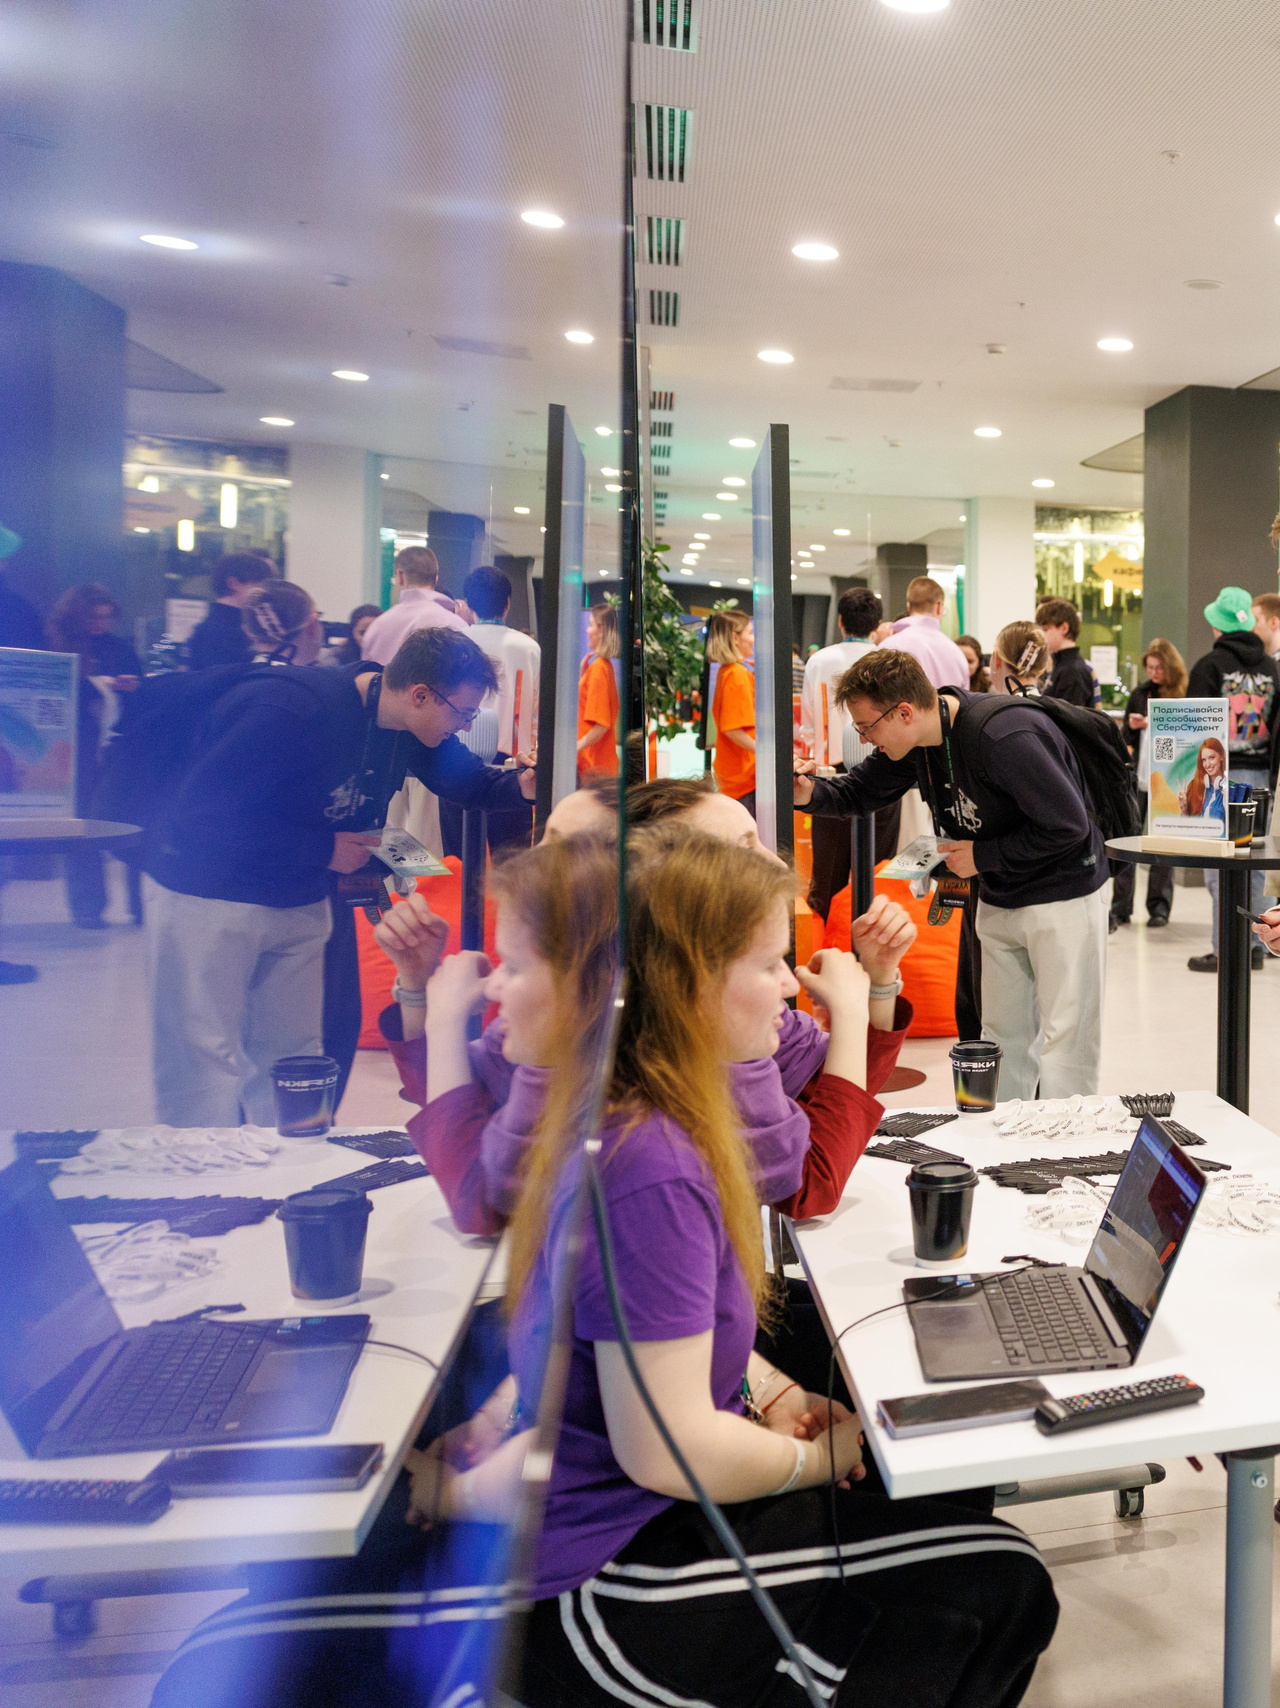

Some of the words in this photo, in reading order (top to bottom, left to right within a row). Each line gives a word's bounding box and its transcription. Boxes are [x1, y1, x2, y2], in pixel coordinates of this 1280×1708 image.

[1153, 706, 1223, 714] Подписывайся
[1166, 715, 1224, 723] сообщество
[1156, 724, 1220, 732] СберСтудент
